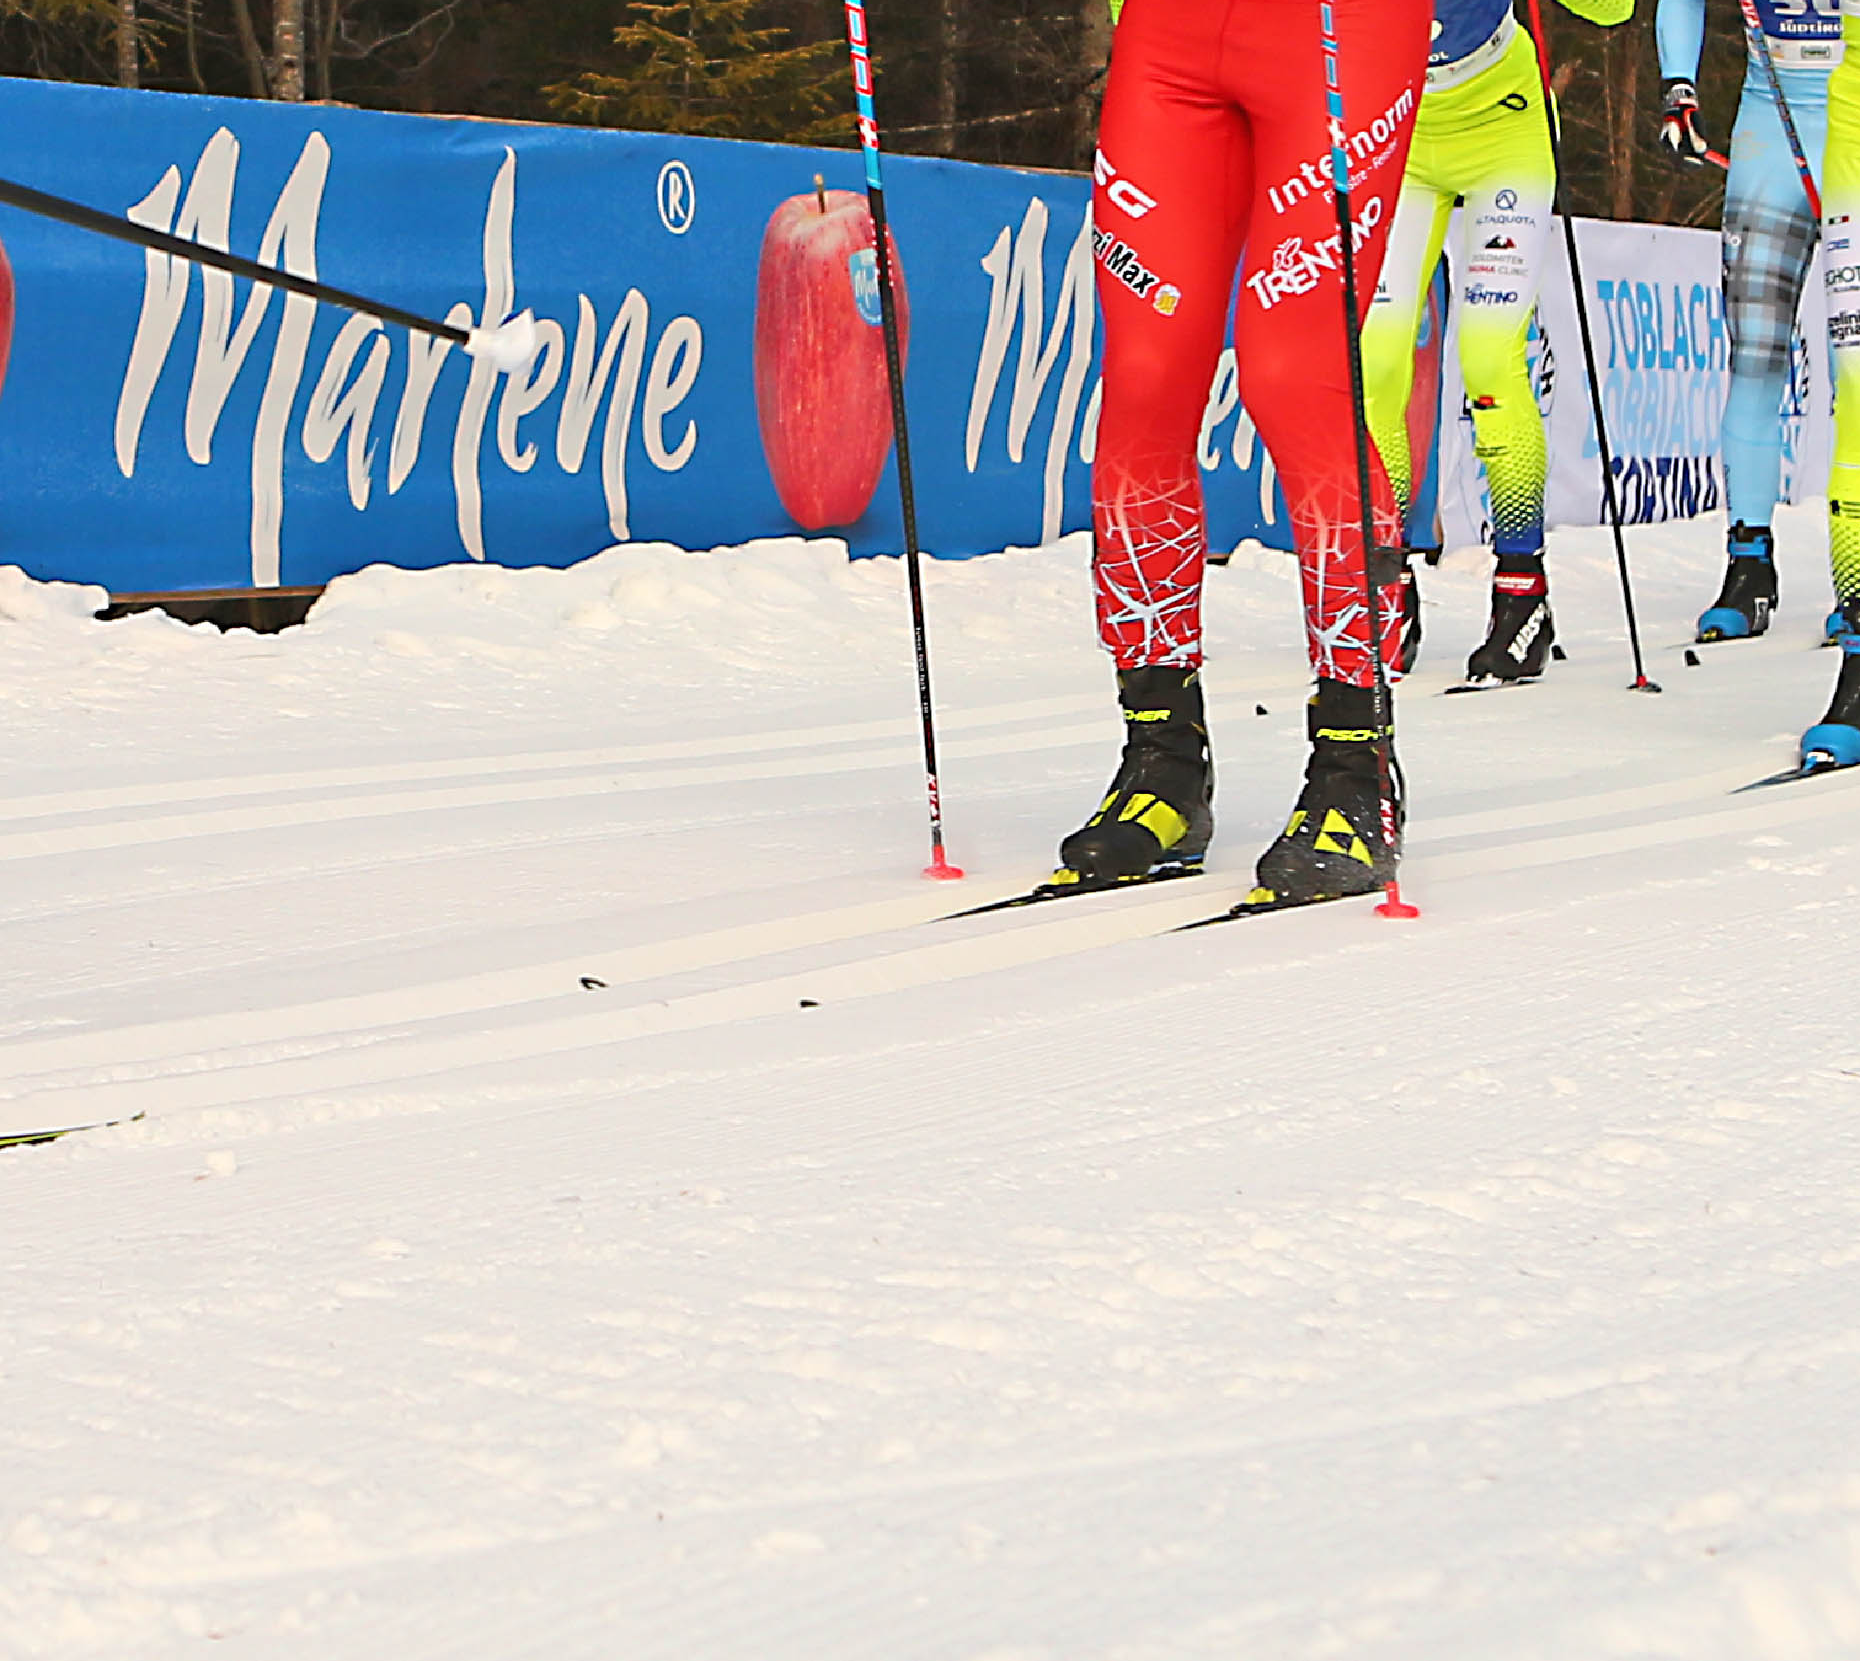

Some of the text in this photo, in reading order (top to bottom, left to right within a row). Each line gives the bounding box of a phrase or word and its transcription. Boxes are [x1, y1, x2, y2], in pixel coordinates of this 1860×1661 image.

[1105, 242, 1157, 297] Max
[114, 126, 704, 588] Marlene
[1597, 279, 1727, 372] TOBLACH
